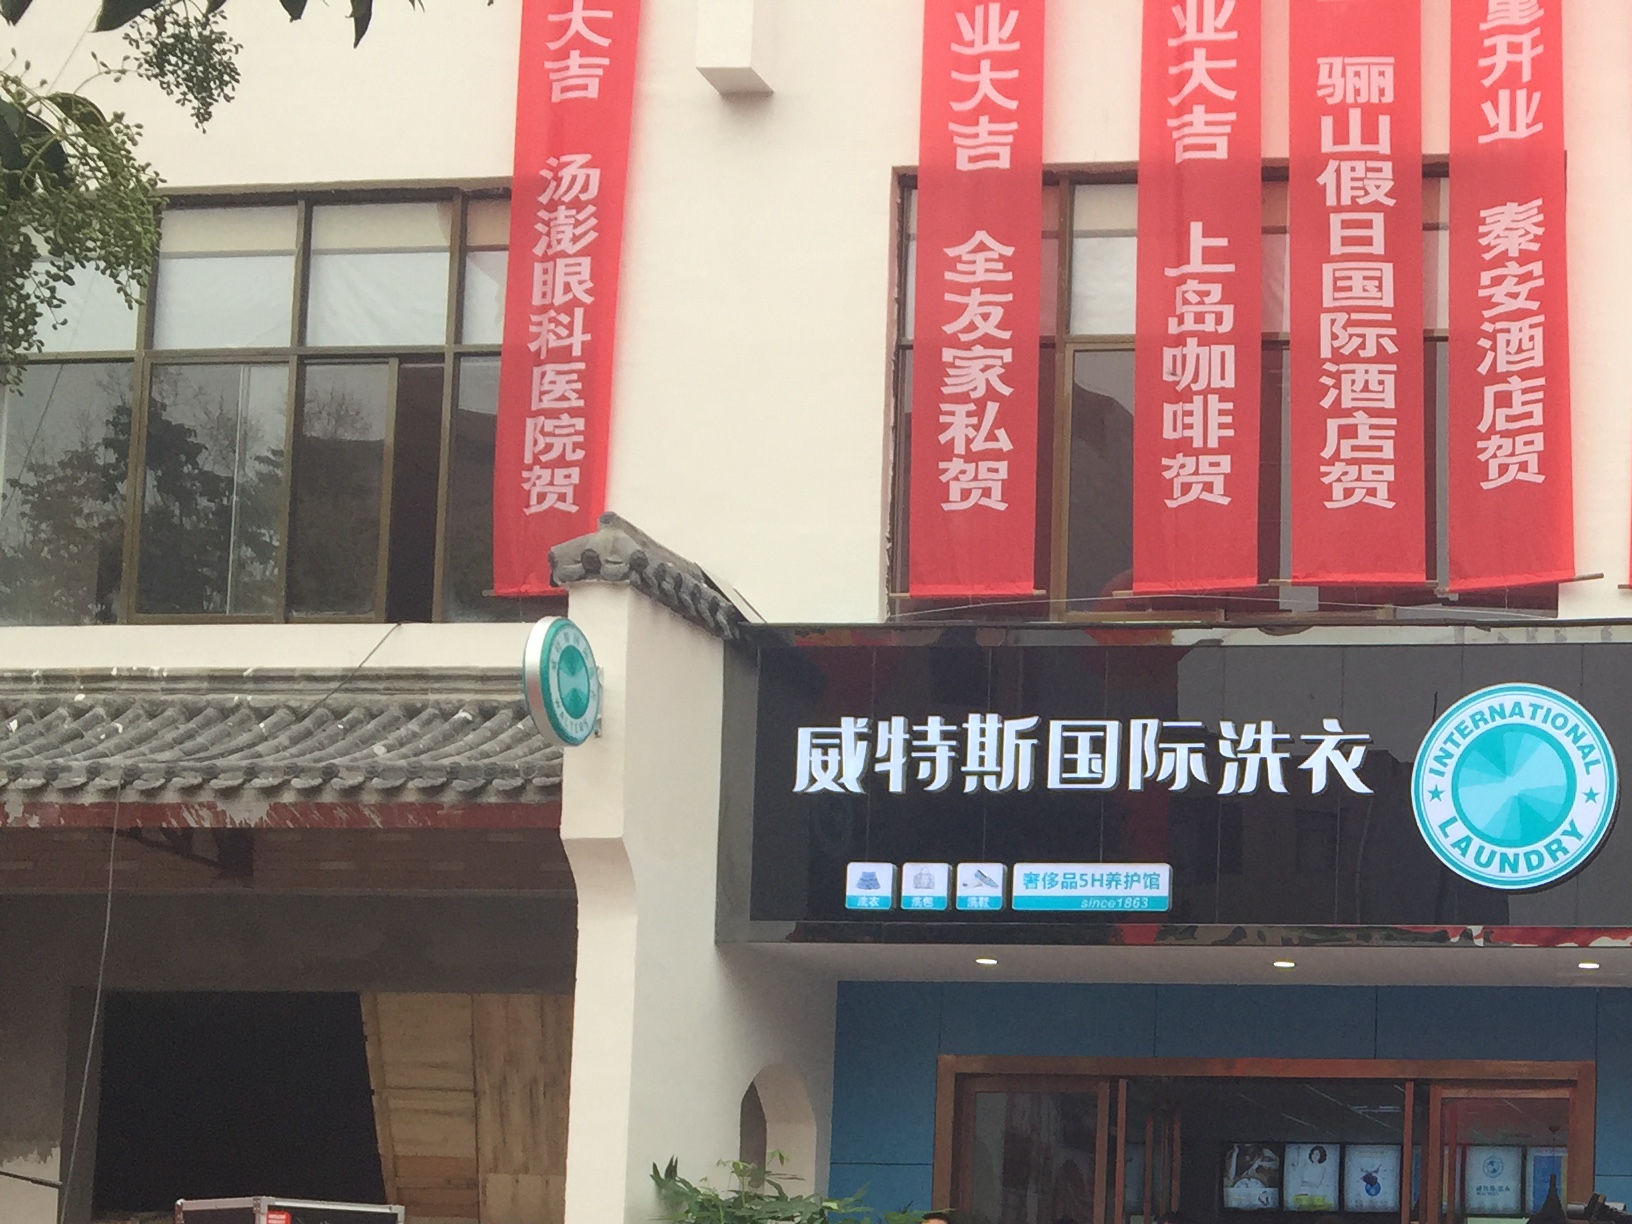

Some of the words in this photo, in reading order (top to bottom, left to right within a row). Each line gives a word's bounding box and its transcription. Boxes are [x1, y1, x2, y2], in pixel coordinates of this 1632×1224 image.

[545, 0, 613, 103] 大吉
[948, 2, 1020, 172] 业大吉
[1166, 0, 1238, 164] 业大吉
[521, 153, 602, 516] 汤澎眼科医院贺
[1161, 221, 1236, 509] 上岛咖啡贺
[1316, 56, 1399, 509] 骊山假日国际酒店贺
[1476, 198, 1546, 490] 秦安酒店贺
[938, 230, 1015, 511] 全友家私贺
[793, 713, 1374, 796] 威特斯国际洗衣
[1429, 701, 1602, 778] INTERNATIONAL
[1022, 871, 1162, 891] 奢侈品5H养护馆
[1437, 815, 1585, 874] LAUNDRY
